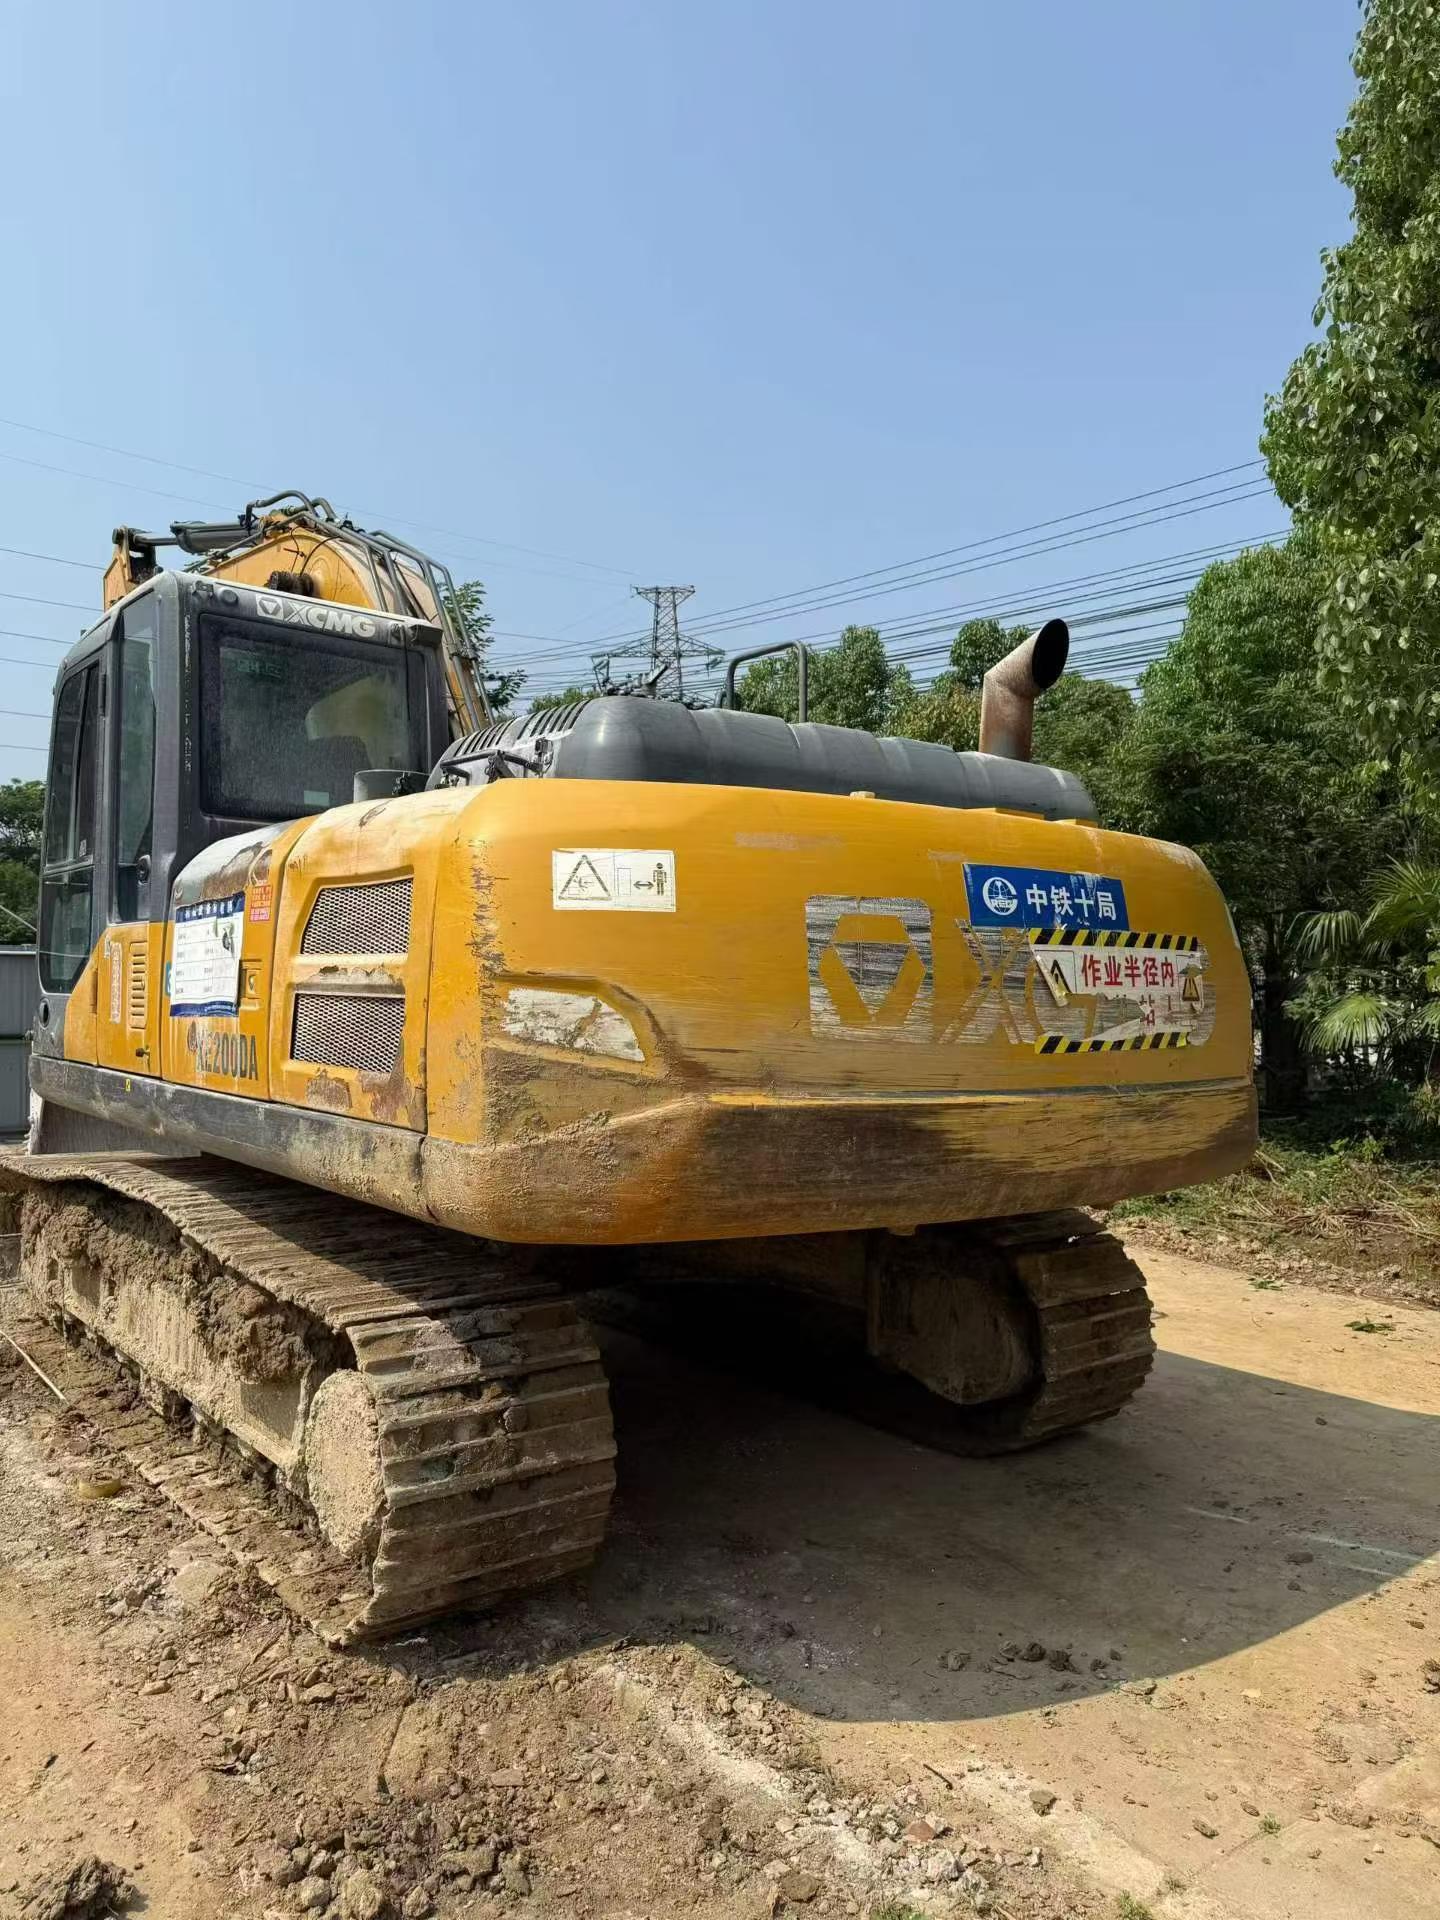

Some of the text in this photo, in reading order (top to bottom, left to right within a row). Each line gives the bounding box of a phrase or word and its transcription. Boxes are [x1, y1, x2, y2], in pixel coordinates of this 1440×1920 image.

[285, 600, 376, 638] XCMG
[1025, 883, 1117, 921] 中铁十局
[1081, 954, 1175, 988] 作业半径内
